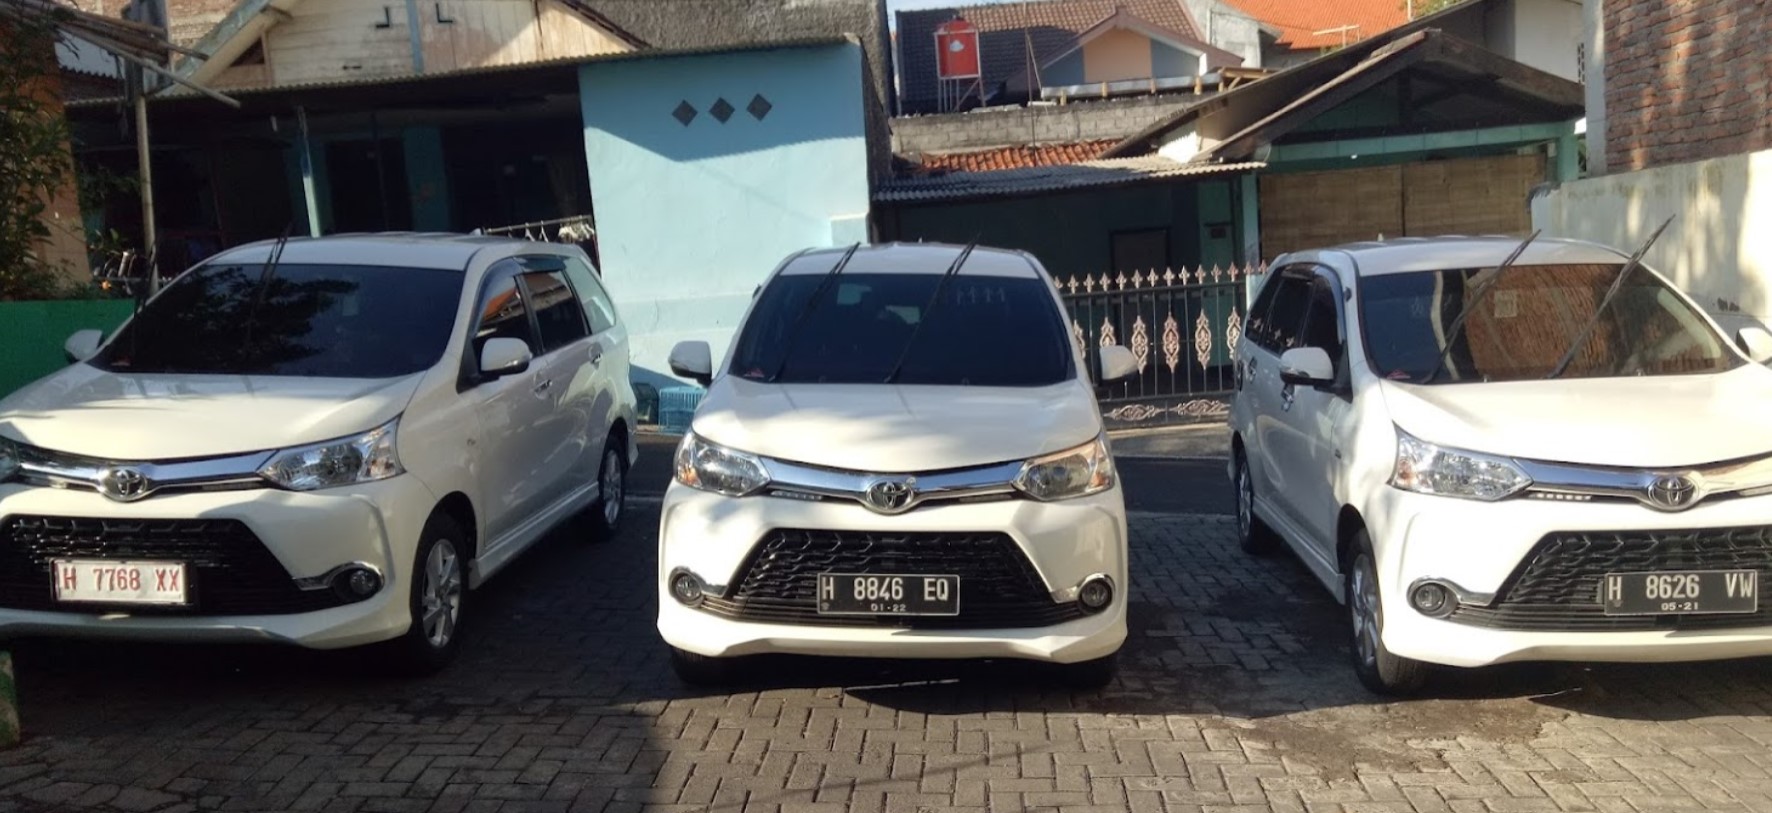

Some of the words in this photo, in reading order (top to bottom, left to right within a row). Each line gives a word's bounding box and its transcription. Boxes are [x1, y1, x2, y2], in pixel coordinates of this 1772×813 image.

[63, 566, 77, 591] H
[93, 568, 141, 592] 7768
[155, 568, 180, 592] XX
[821, 576, 834, 600] H
[853, 577, 903, 600] 8846
[923, 577, 949, 601] EQ
[1608, 576, 1622, 600] H
[1645, 574, 1700, 599] 8626
[1725, 573, 1754, 598] VW
